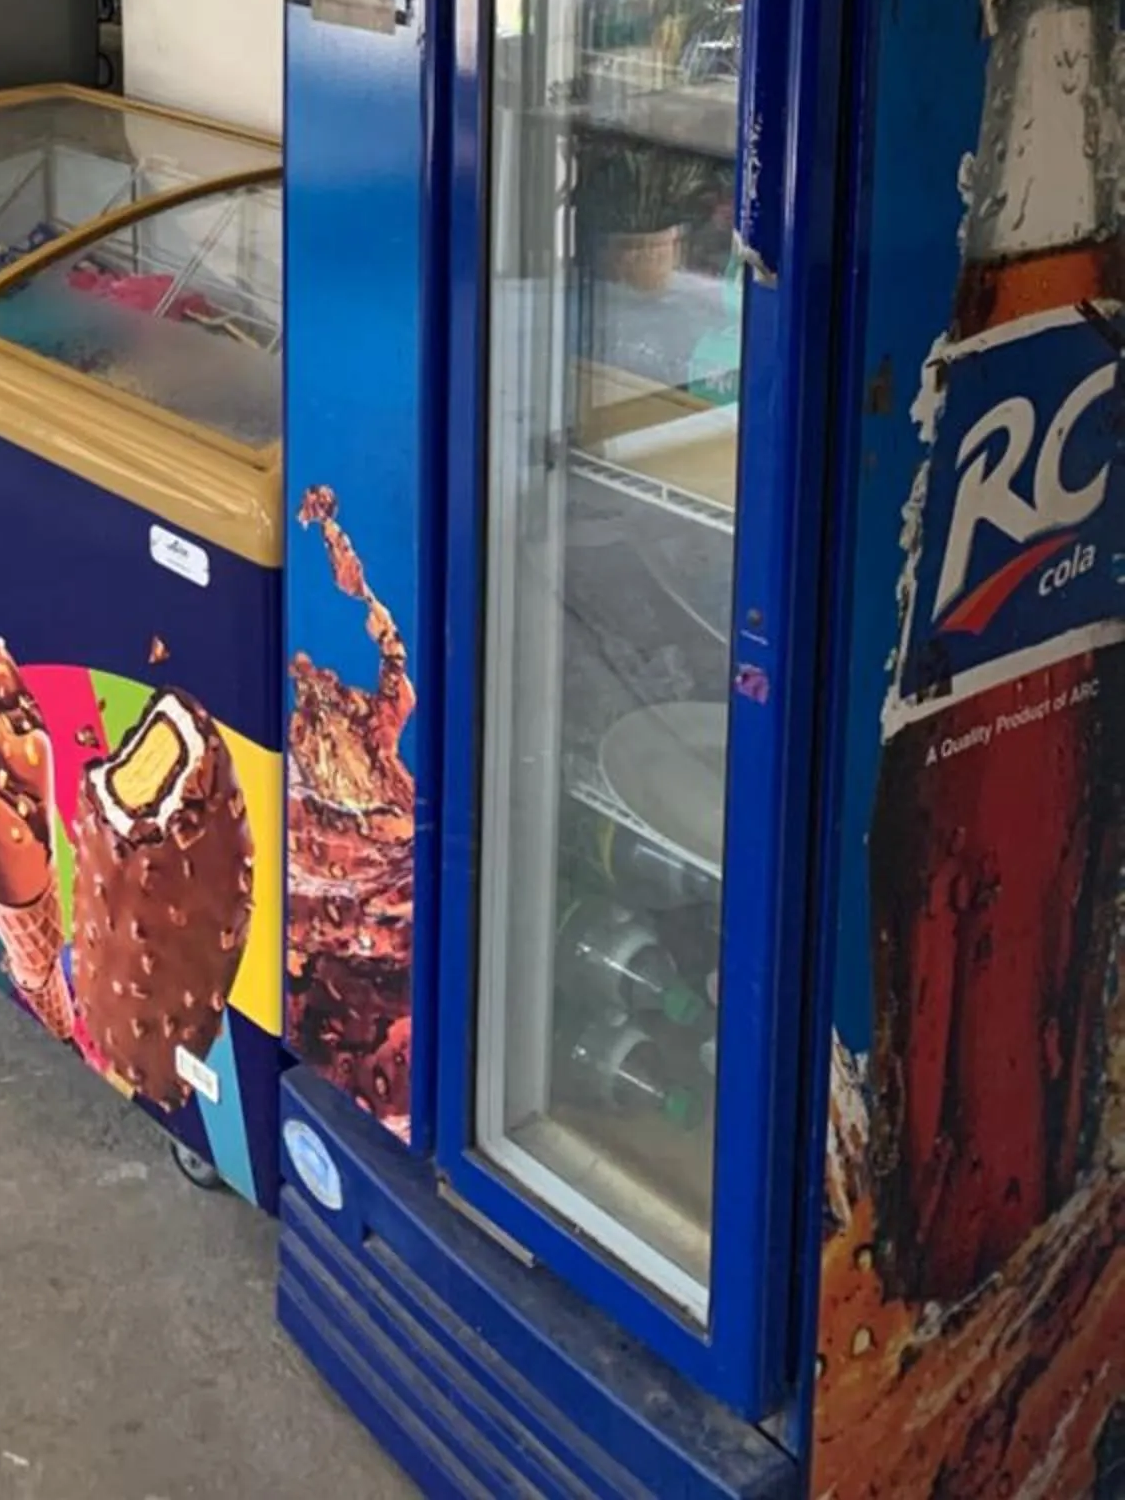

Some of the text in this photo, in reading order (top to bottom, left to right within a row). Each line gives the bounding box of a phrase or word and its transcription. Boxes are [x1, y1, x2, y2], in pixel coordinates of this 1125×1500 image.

[932, 362, 1118, 623] RC
[1038, 543, 1096, 597] cola
[925, 677, 1100, 766] A Quality Product of ARC
